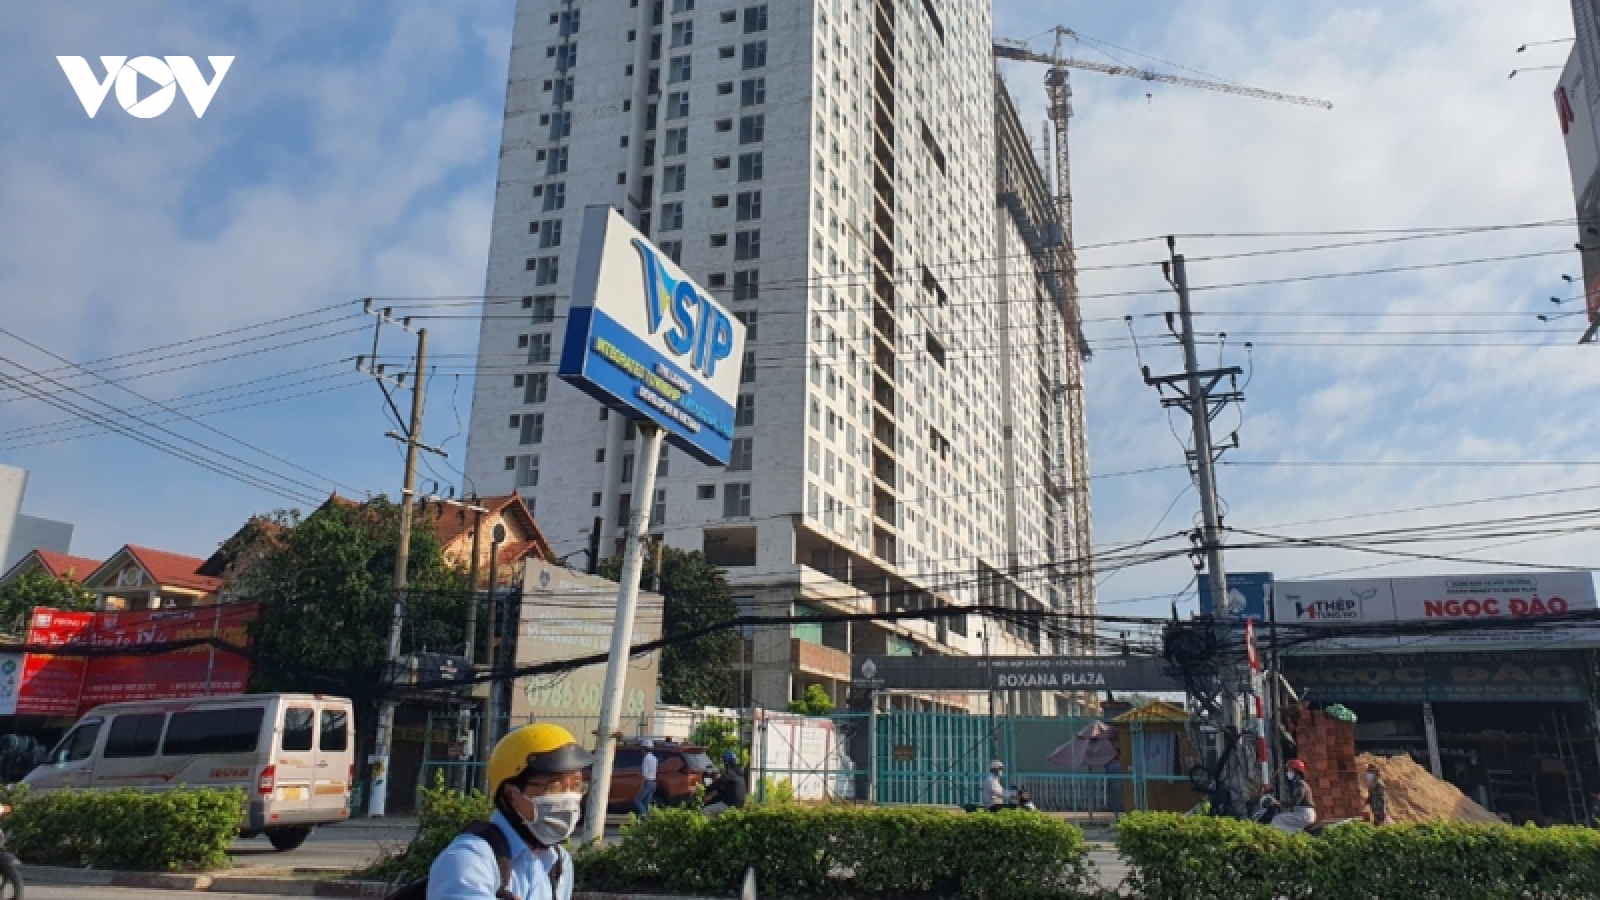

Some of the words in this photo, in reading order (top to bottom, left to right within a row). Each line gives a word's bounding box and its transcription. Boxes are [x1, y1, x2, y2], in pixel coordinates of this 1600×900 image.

[1423, 598, 1500, 619] NGỌC
[998, 673, 1058, 687] ROXANA
[1061, 671, 1106, 685] PLAZA
